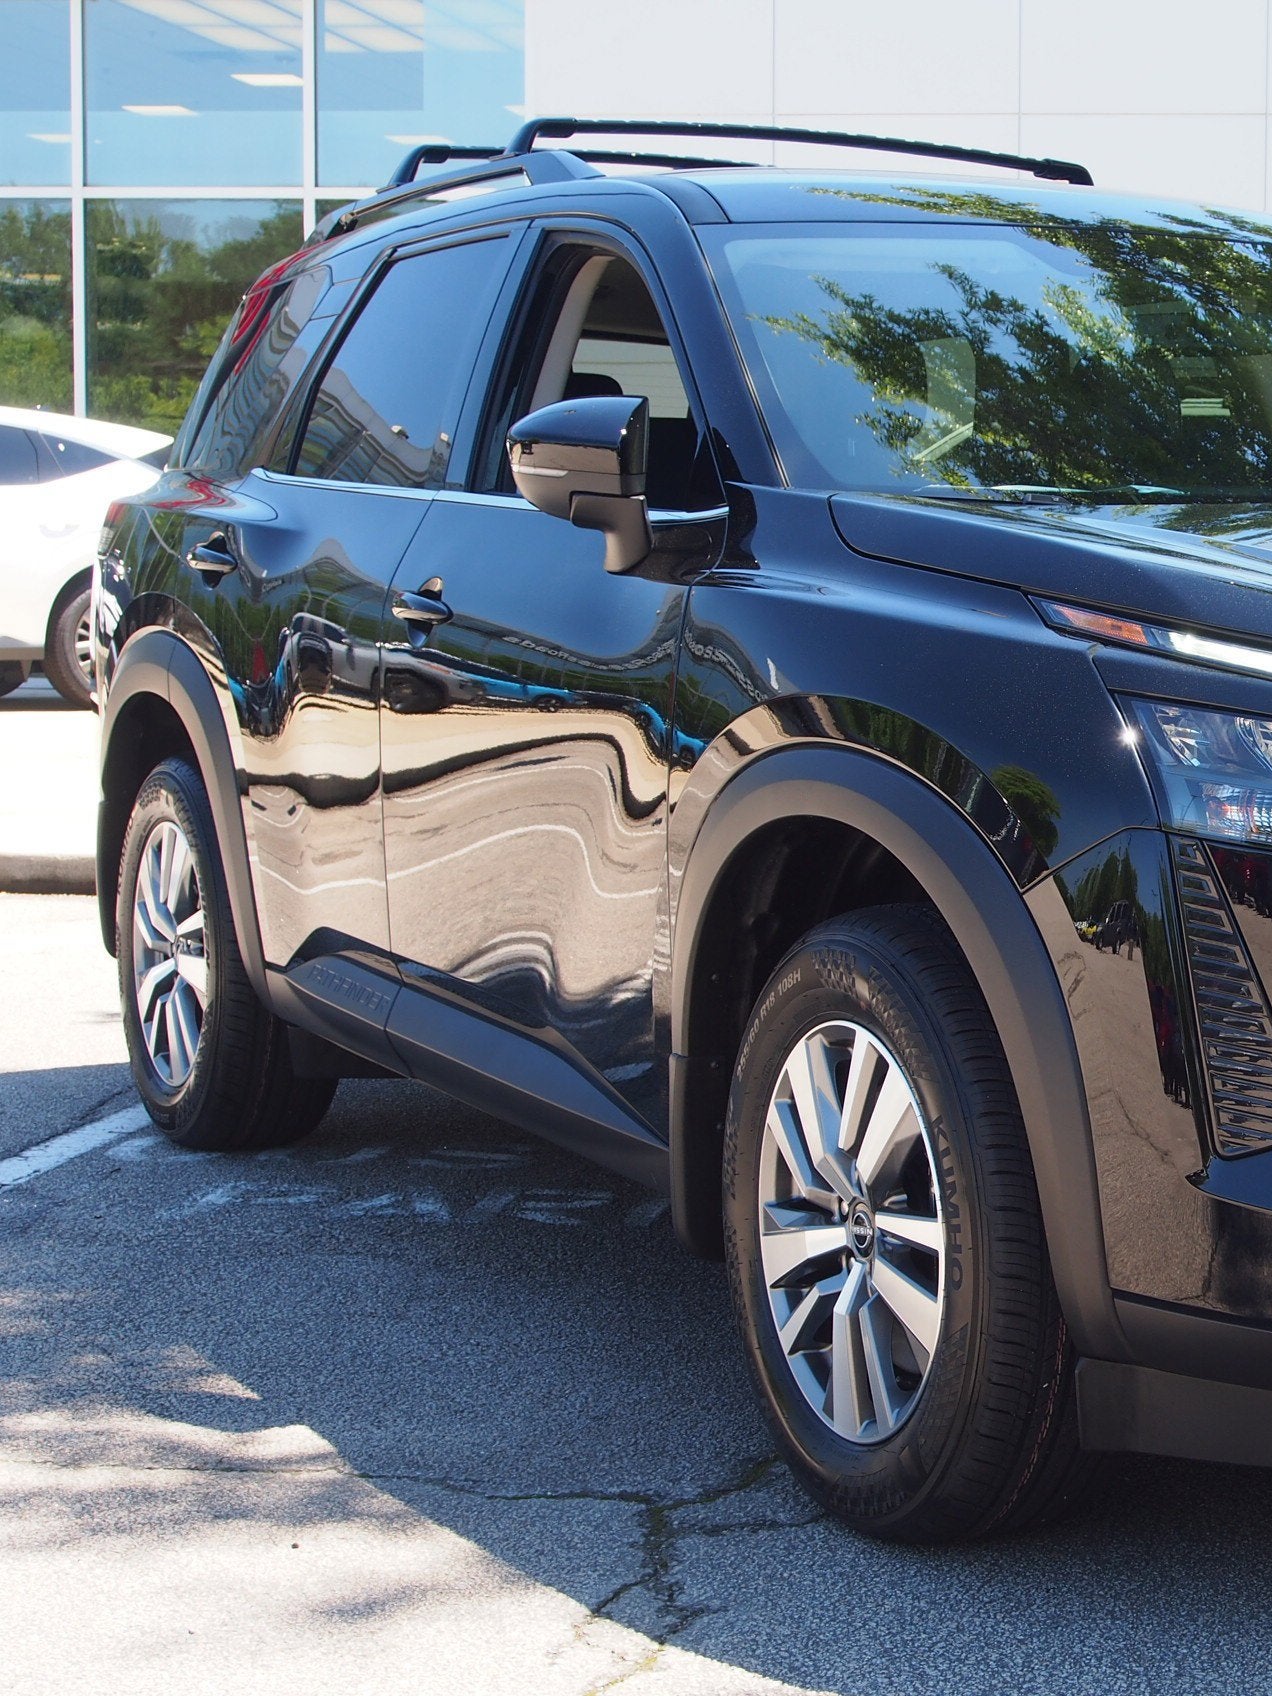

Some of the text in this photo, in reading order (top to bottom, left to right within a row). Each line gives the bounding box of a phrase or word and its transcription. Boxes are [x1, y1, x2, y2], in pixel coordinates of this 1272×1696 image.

[307, 963, 391, 1012] PATHFINDER
[760, 992, 776, 1021] R18
[777, 968, 801, 996] 108H
[932, 1115, 963, 1291] KUMHO
